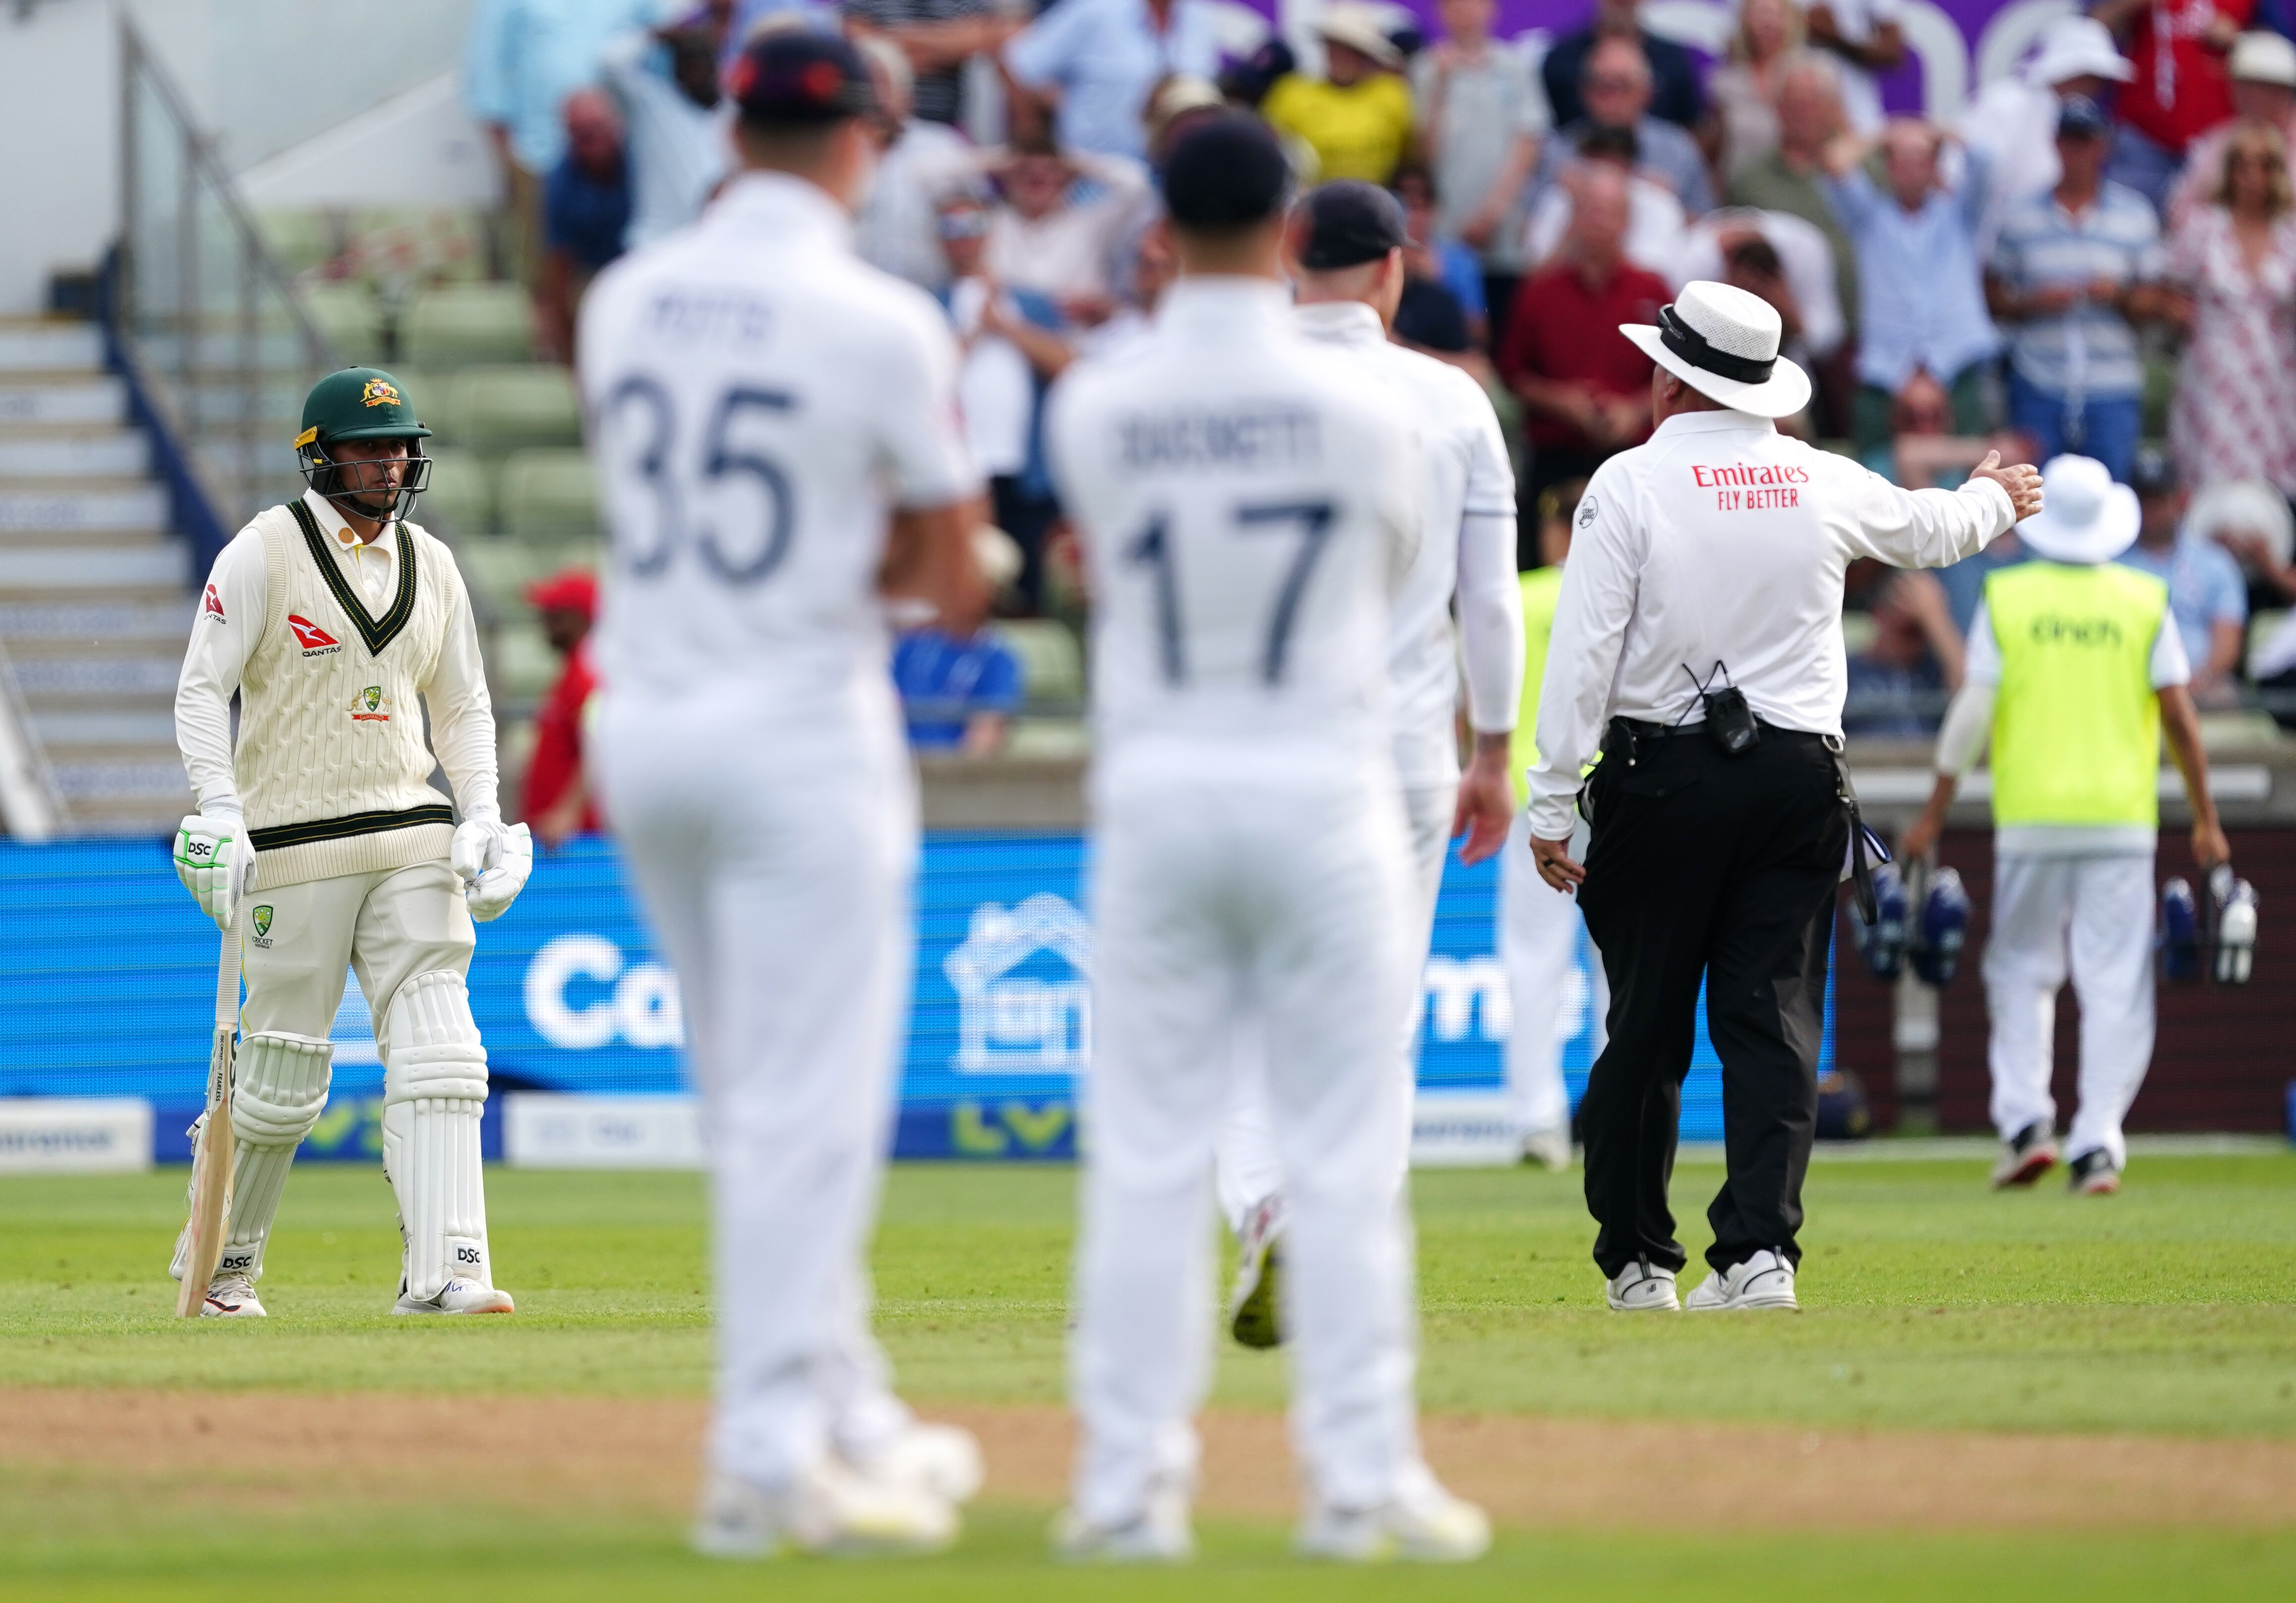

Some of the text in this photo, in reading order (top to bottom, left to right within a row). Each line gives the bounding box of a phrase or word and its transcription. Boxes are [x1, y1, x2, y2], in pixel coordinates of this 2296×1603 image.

[607, 374, 801, 588] 35
[1691, 462, 1809, 487] Emirates
[1718, 488, 1798, 511] FLY BETTER
[1119, 502, 1340, 685] 17
[302, 646, 342, 657] QANTAS
[188, 842, 211, 856] DSC
[252, 936, 274, 946] CRICKET
[222, 1256, 252, 1269] DSC
[458, 1248, 480, 1263] DSC
